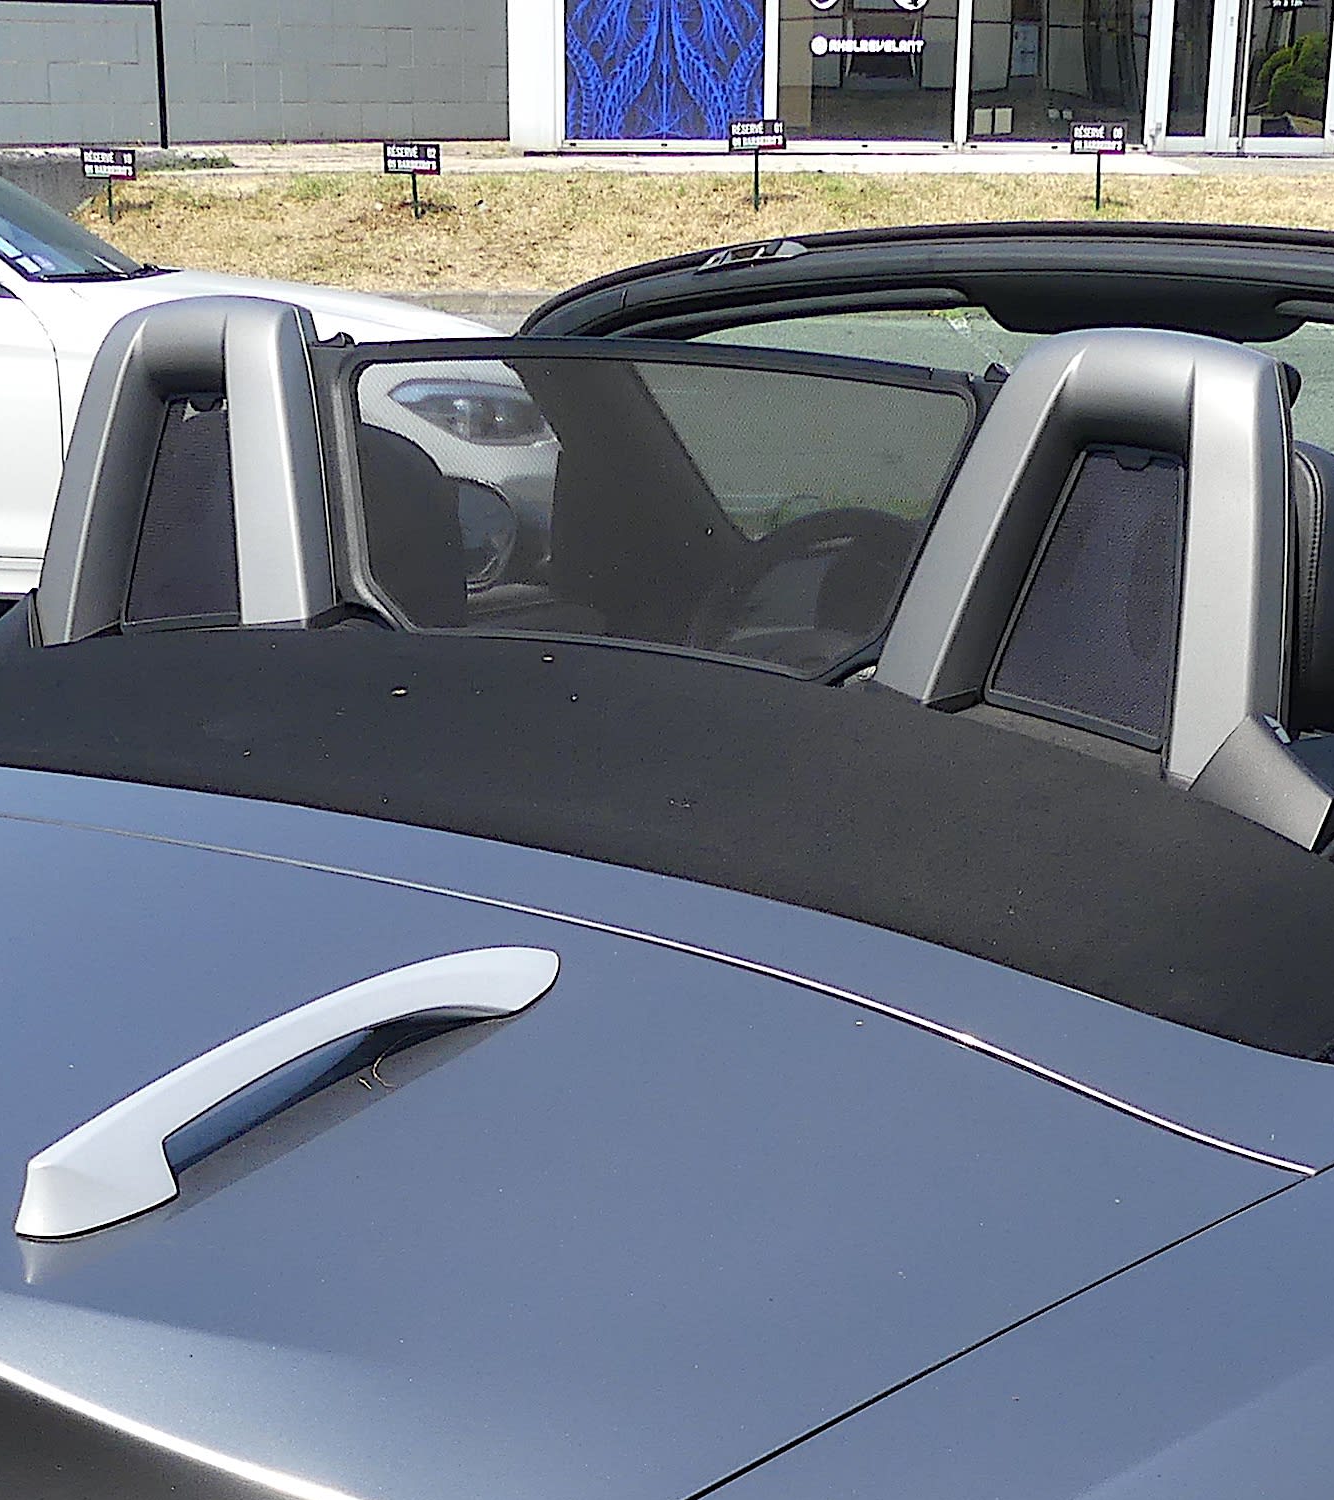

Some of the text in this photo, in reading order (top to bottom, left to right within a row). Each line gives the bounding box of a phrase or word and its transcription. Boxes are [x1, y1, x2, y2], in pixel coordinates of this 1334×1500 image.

[731, 121, 764, 135] RÉSERVÉ
[1074, 125, 1105, 139] RÉSERVÉ
[83, 149, 115, 163] RÉSERVÉ
[387, 144, 419, 158] RÉSERVÉ
